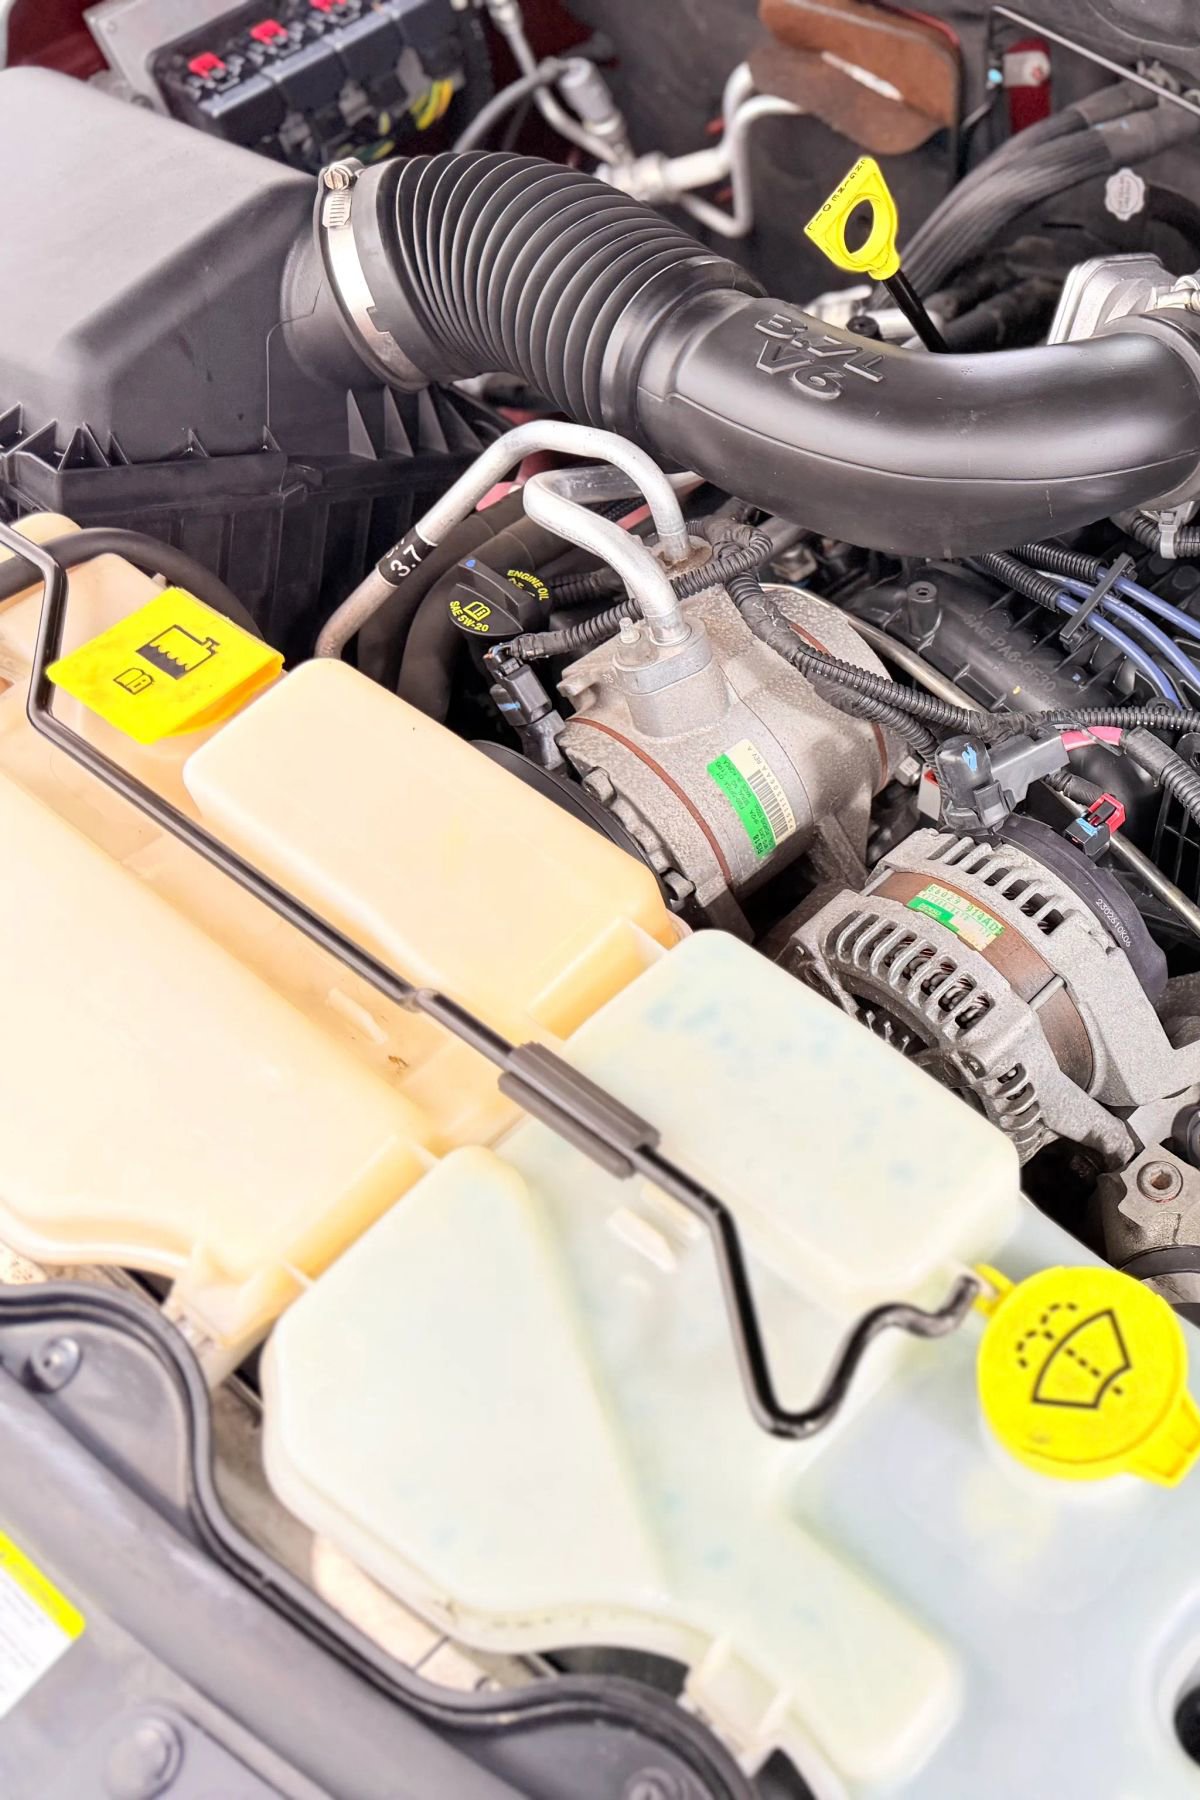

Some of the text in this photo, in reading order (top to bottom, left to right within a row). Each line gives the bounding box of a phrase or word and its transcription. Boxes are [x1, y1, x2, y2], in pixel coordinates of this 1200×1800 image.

[806, 204, 830, 231] OIL
[753, 309, 884, 383] 3.7L
[755, 338, 846, 394] V6
[391, 543, 422, 575] 3.7
[506, 569, 549, 600] ENGINE OIL
[449, 600, 489, 632] SAE 5W-20
[988, 634, 1059, 694] PA6-GF30
[1094, 897, 1132, 948] 2302610K06
